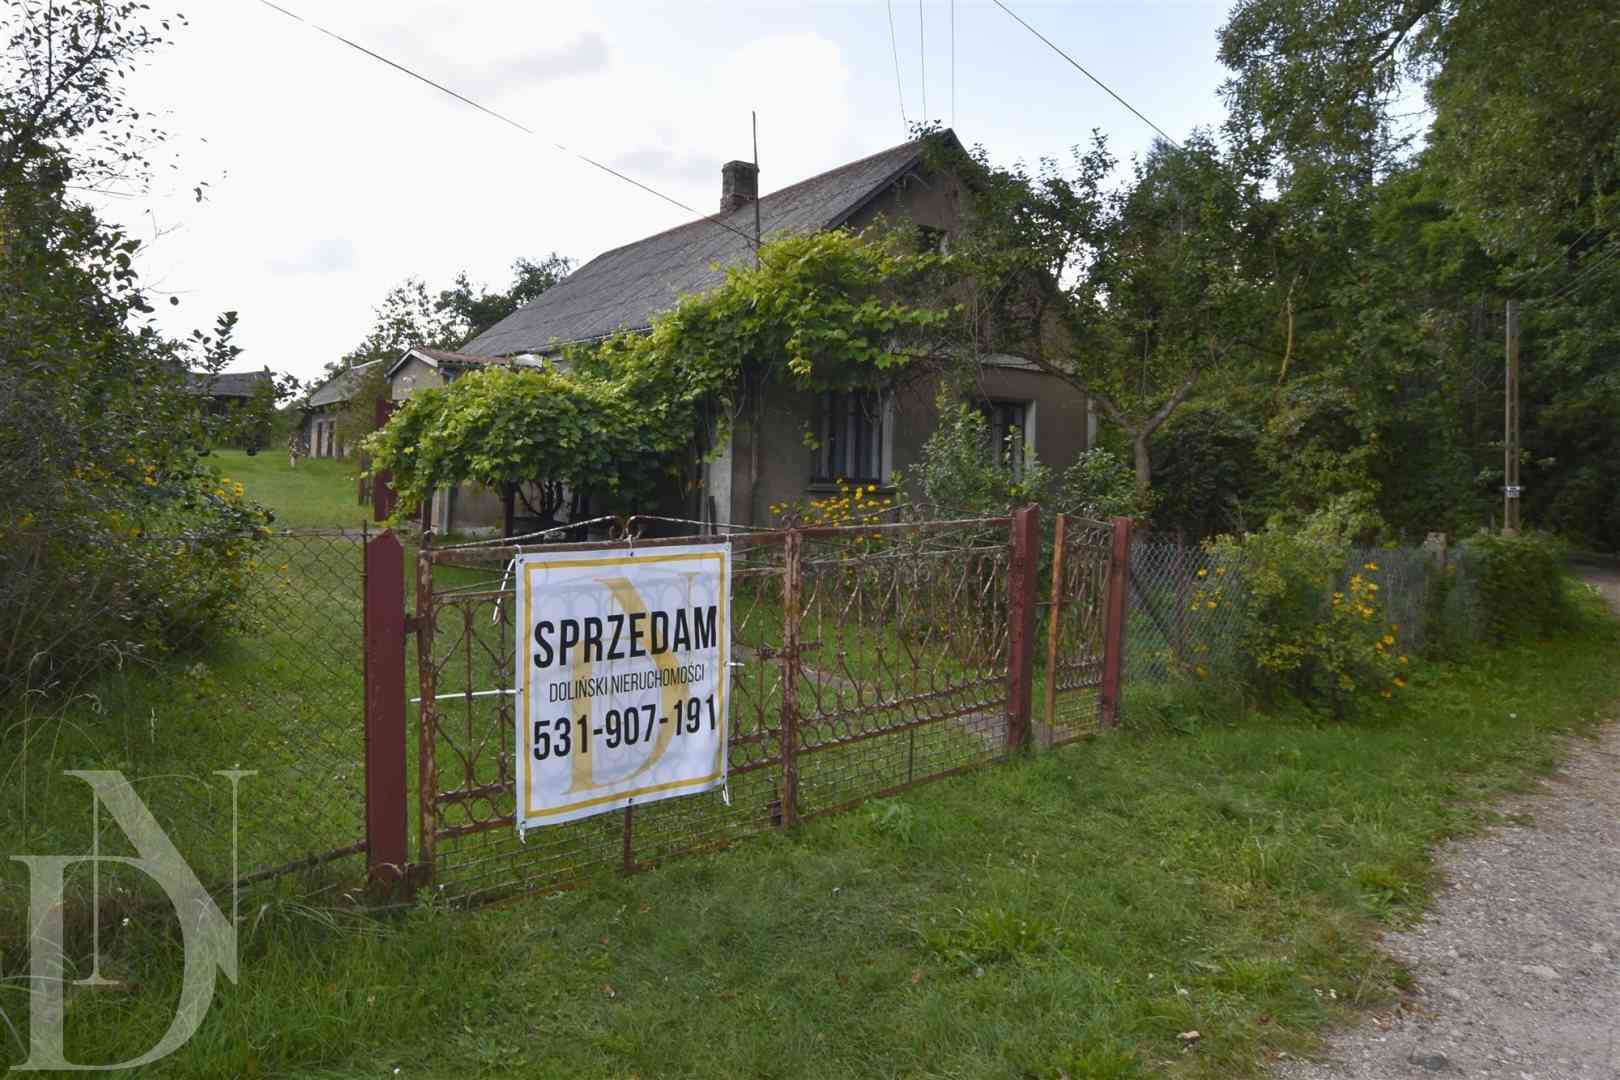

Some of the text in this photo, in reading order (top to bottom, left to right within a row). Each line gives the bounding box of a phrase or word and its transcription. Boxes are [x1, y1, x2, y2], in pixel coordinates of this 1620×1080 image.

[533, 606, 717, 668] SPRZEDAM
[549, 664, 705, 703] DOLIŃSKI NIERUCHOMOŚCI
[533, 694, 716, 760] 531-907-191
